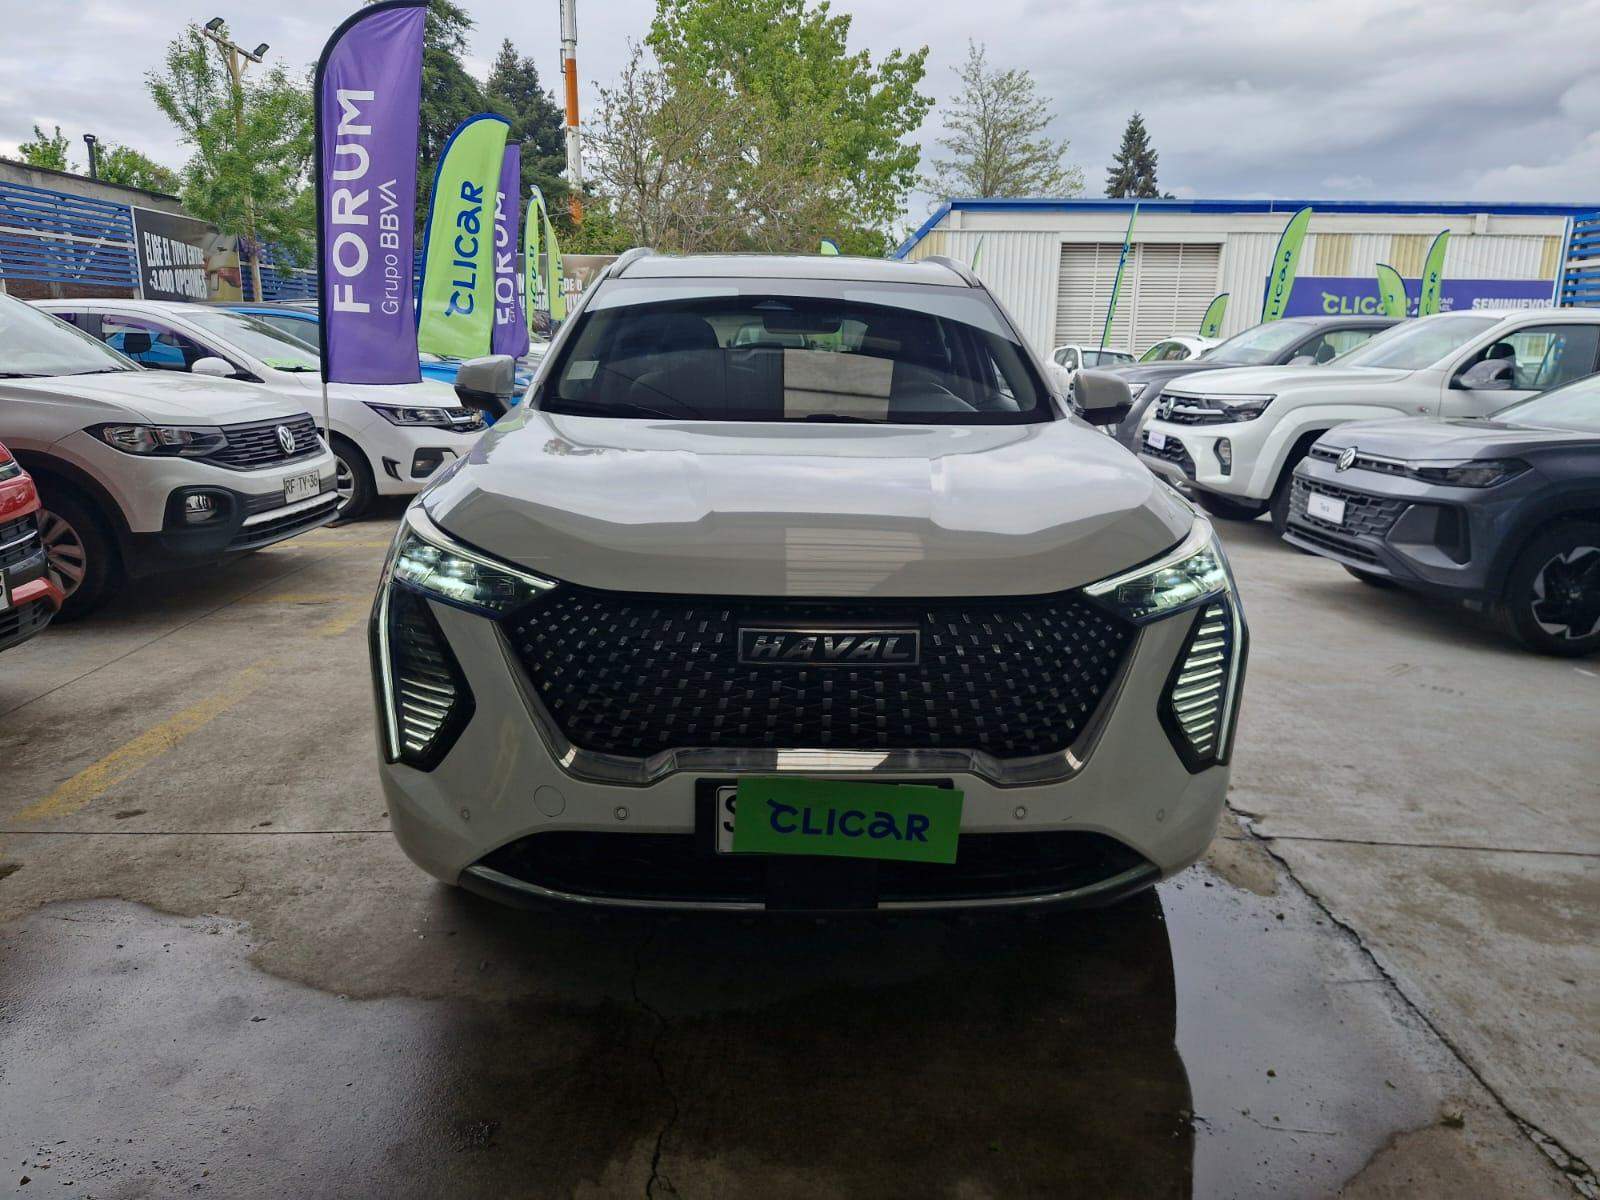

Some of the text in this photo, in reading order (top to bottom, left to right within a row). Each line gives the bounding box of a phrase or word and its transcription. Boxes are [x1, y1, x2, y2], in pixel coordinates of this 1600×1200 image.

[331, 89, 375, 313] FORUM
[377, 178, 402, 315] Grupo BBVA
[752, 635, 910, 658] HAVAL
